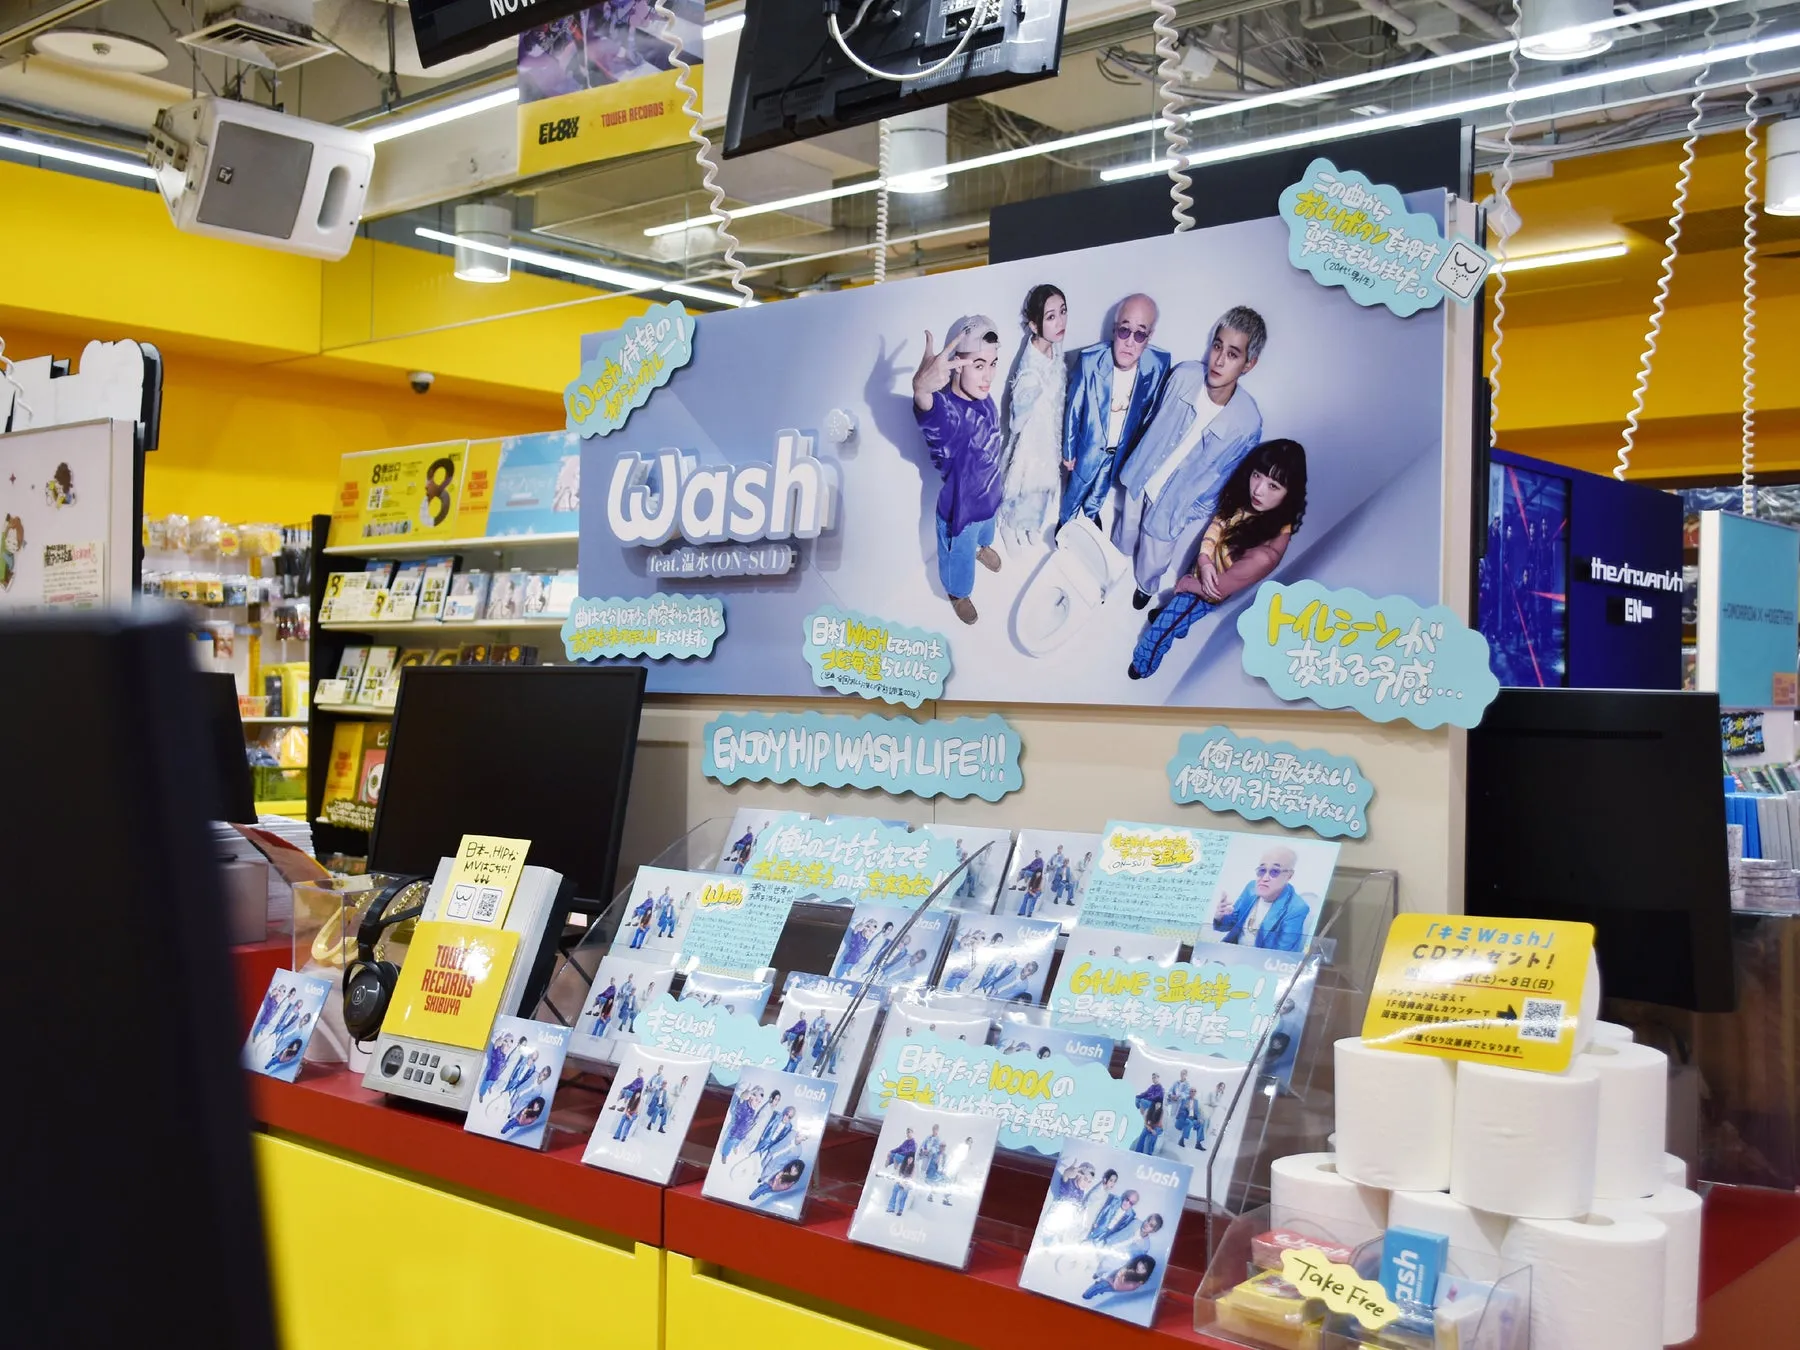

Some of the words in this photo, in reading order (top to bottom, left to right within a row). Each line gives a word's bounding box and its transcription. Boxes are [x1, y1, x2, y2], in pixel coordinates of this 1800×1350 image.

[601, 109, 627, 127] TOWER
[629, 102, 664, 121] RECORDS
[1312, 171, 1392, 222] この曲から
[608, 435, 819, 543] Wash
[650, 554, 680, 573] feat.
[1267, 592, 1444, 658] トイレシーンが
[713, 725, 787, 773] ENJOY
[788, 726, 831, 773] HIP
[835, 731, 911, 780] WASH
[915, 733, 1006, 783] LIFE!!!
[420, 968, 476, 998] RECORDS
[423, 995, 462, 1016] SHIBUYA
[1065, 1039, 1104, 1058] Wash
[794, 1084, 827, 1102] Wash
[1136, 1163, 1181, 1188] Wash
[1291, 1256, 1346, 1296] Take
[1347, 1285, 1386, 1318] Free
